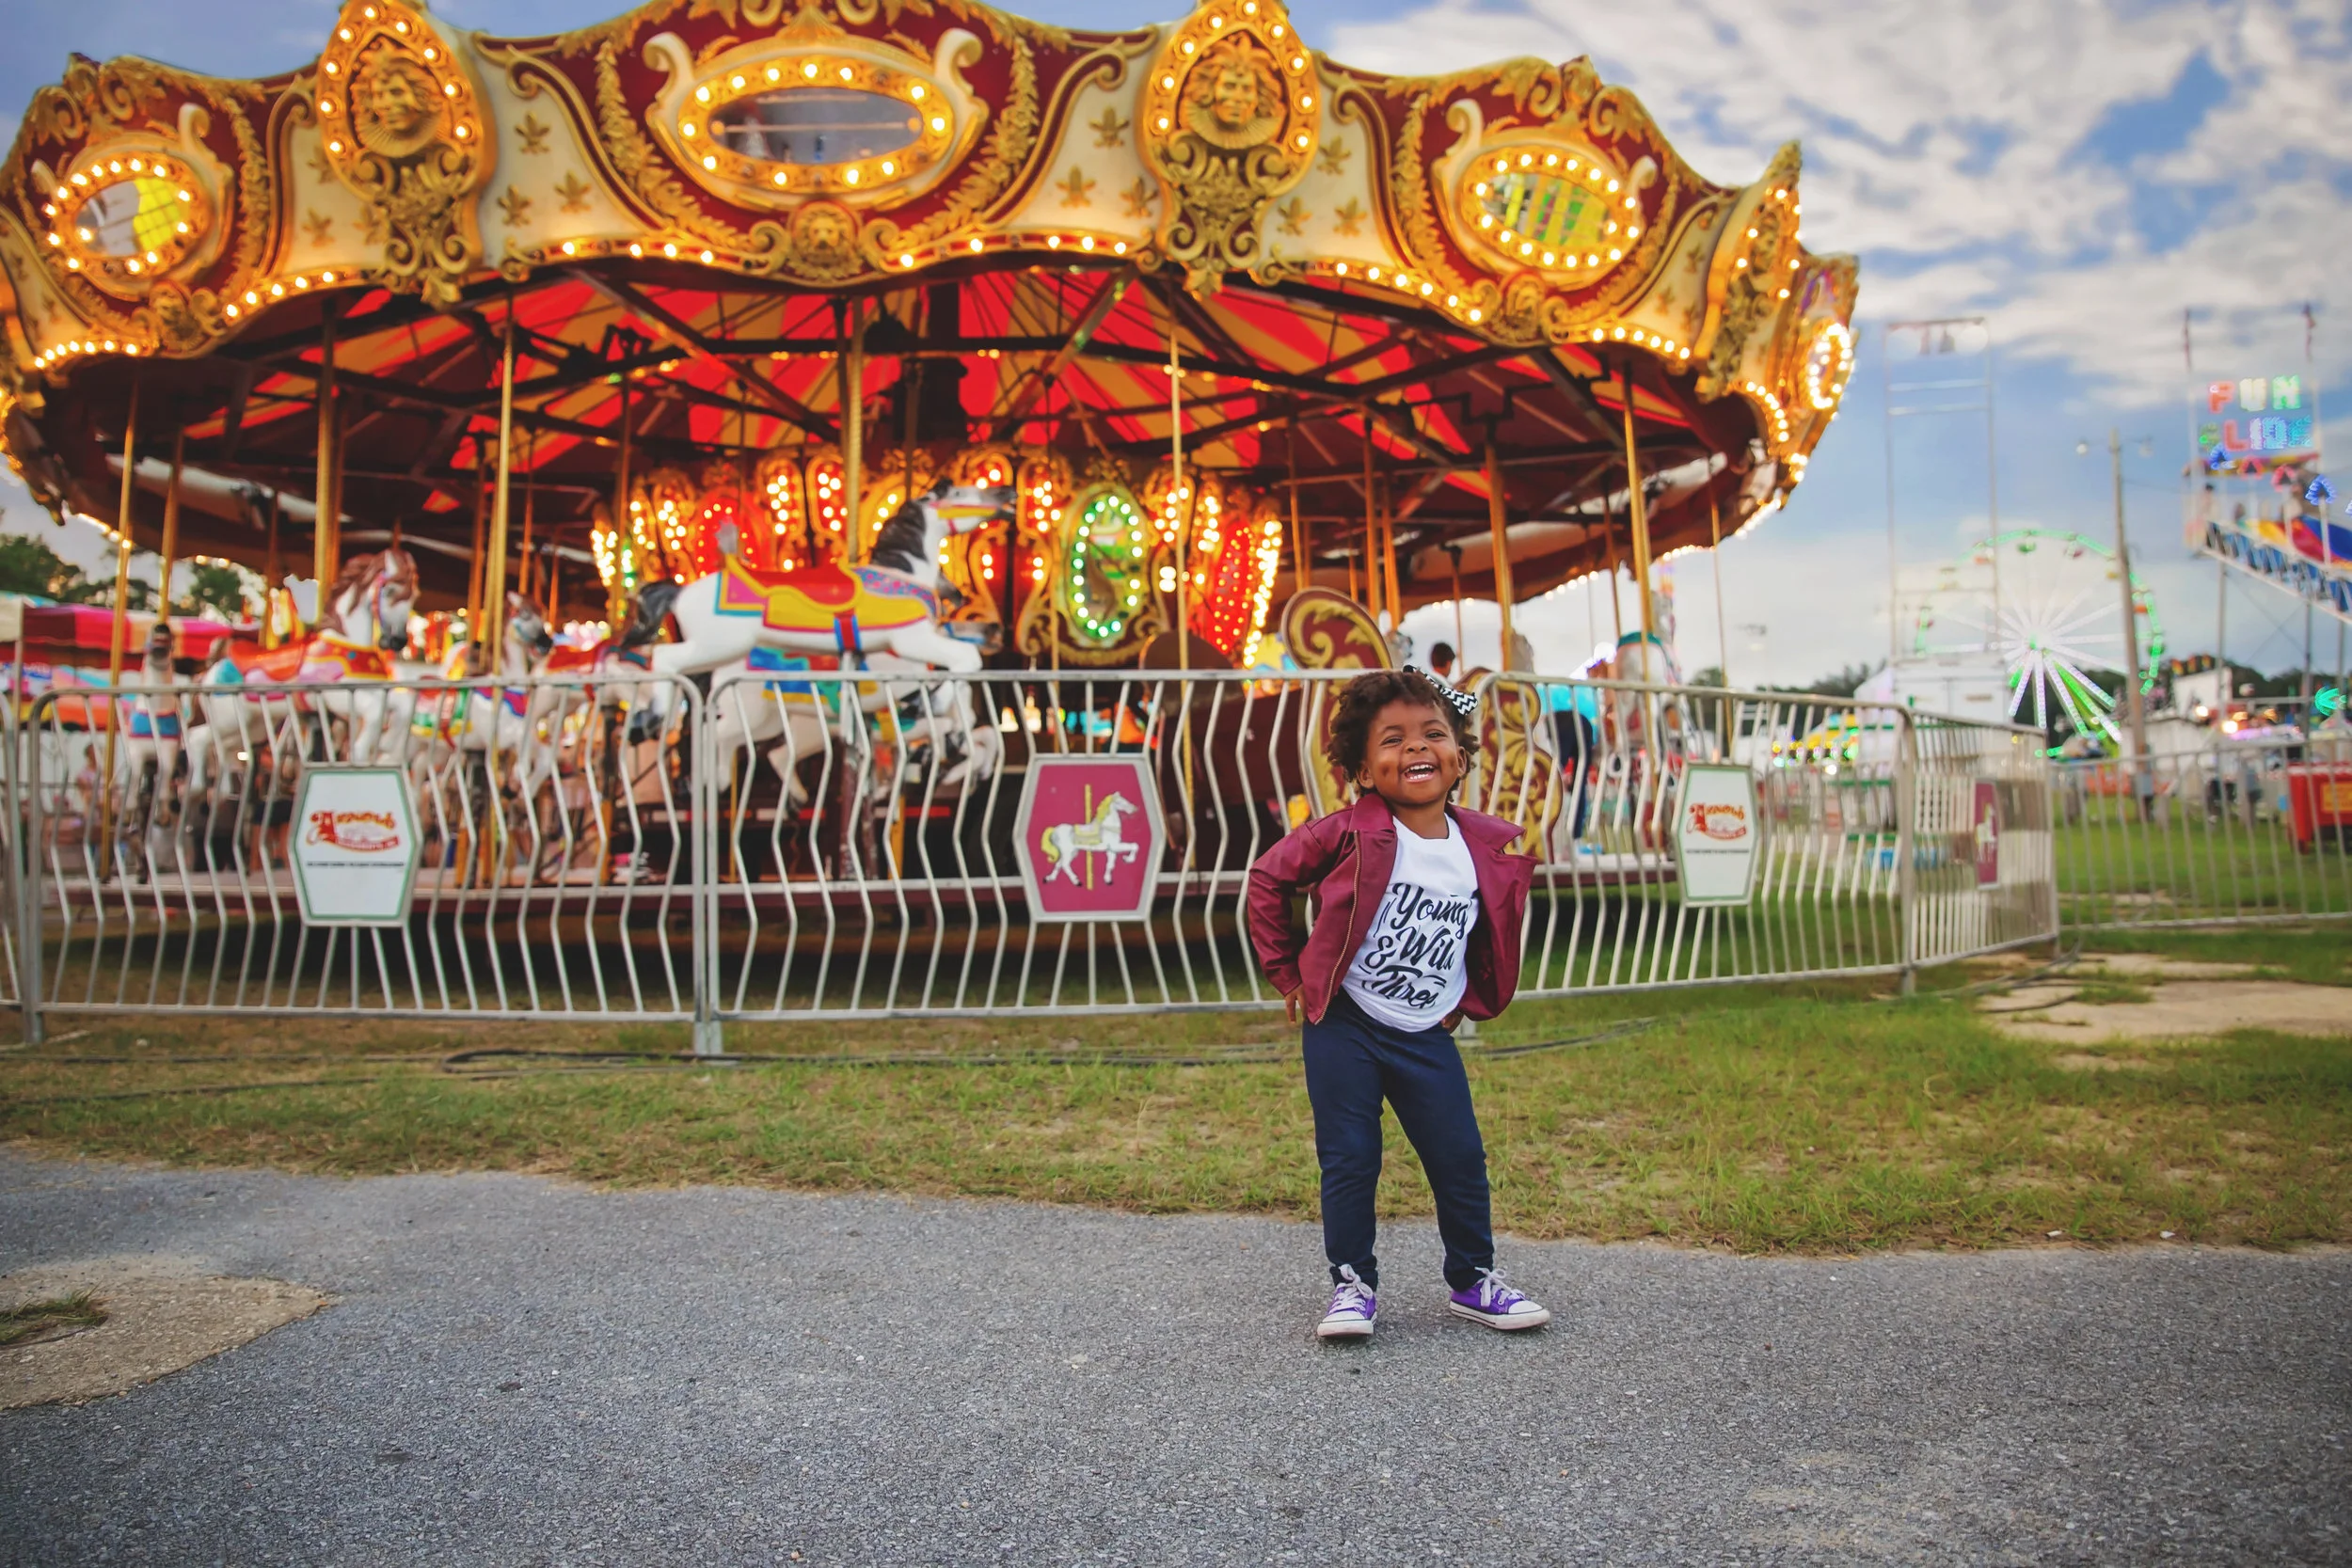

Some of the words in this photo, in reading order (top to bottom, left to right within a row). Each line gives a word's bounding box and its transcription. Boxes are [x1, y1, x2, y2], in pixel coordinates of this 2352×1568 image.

[2208, 375, 2301, 414] FUN
[1390, 882, 1469, 940] Young
[1364, 935, 1397, 970] &
